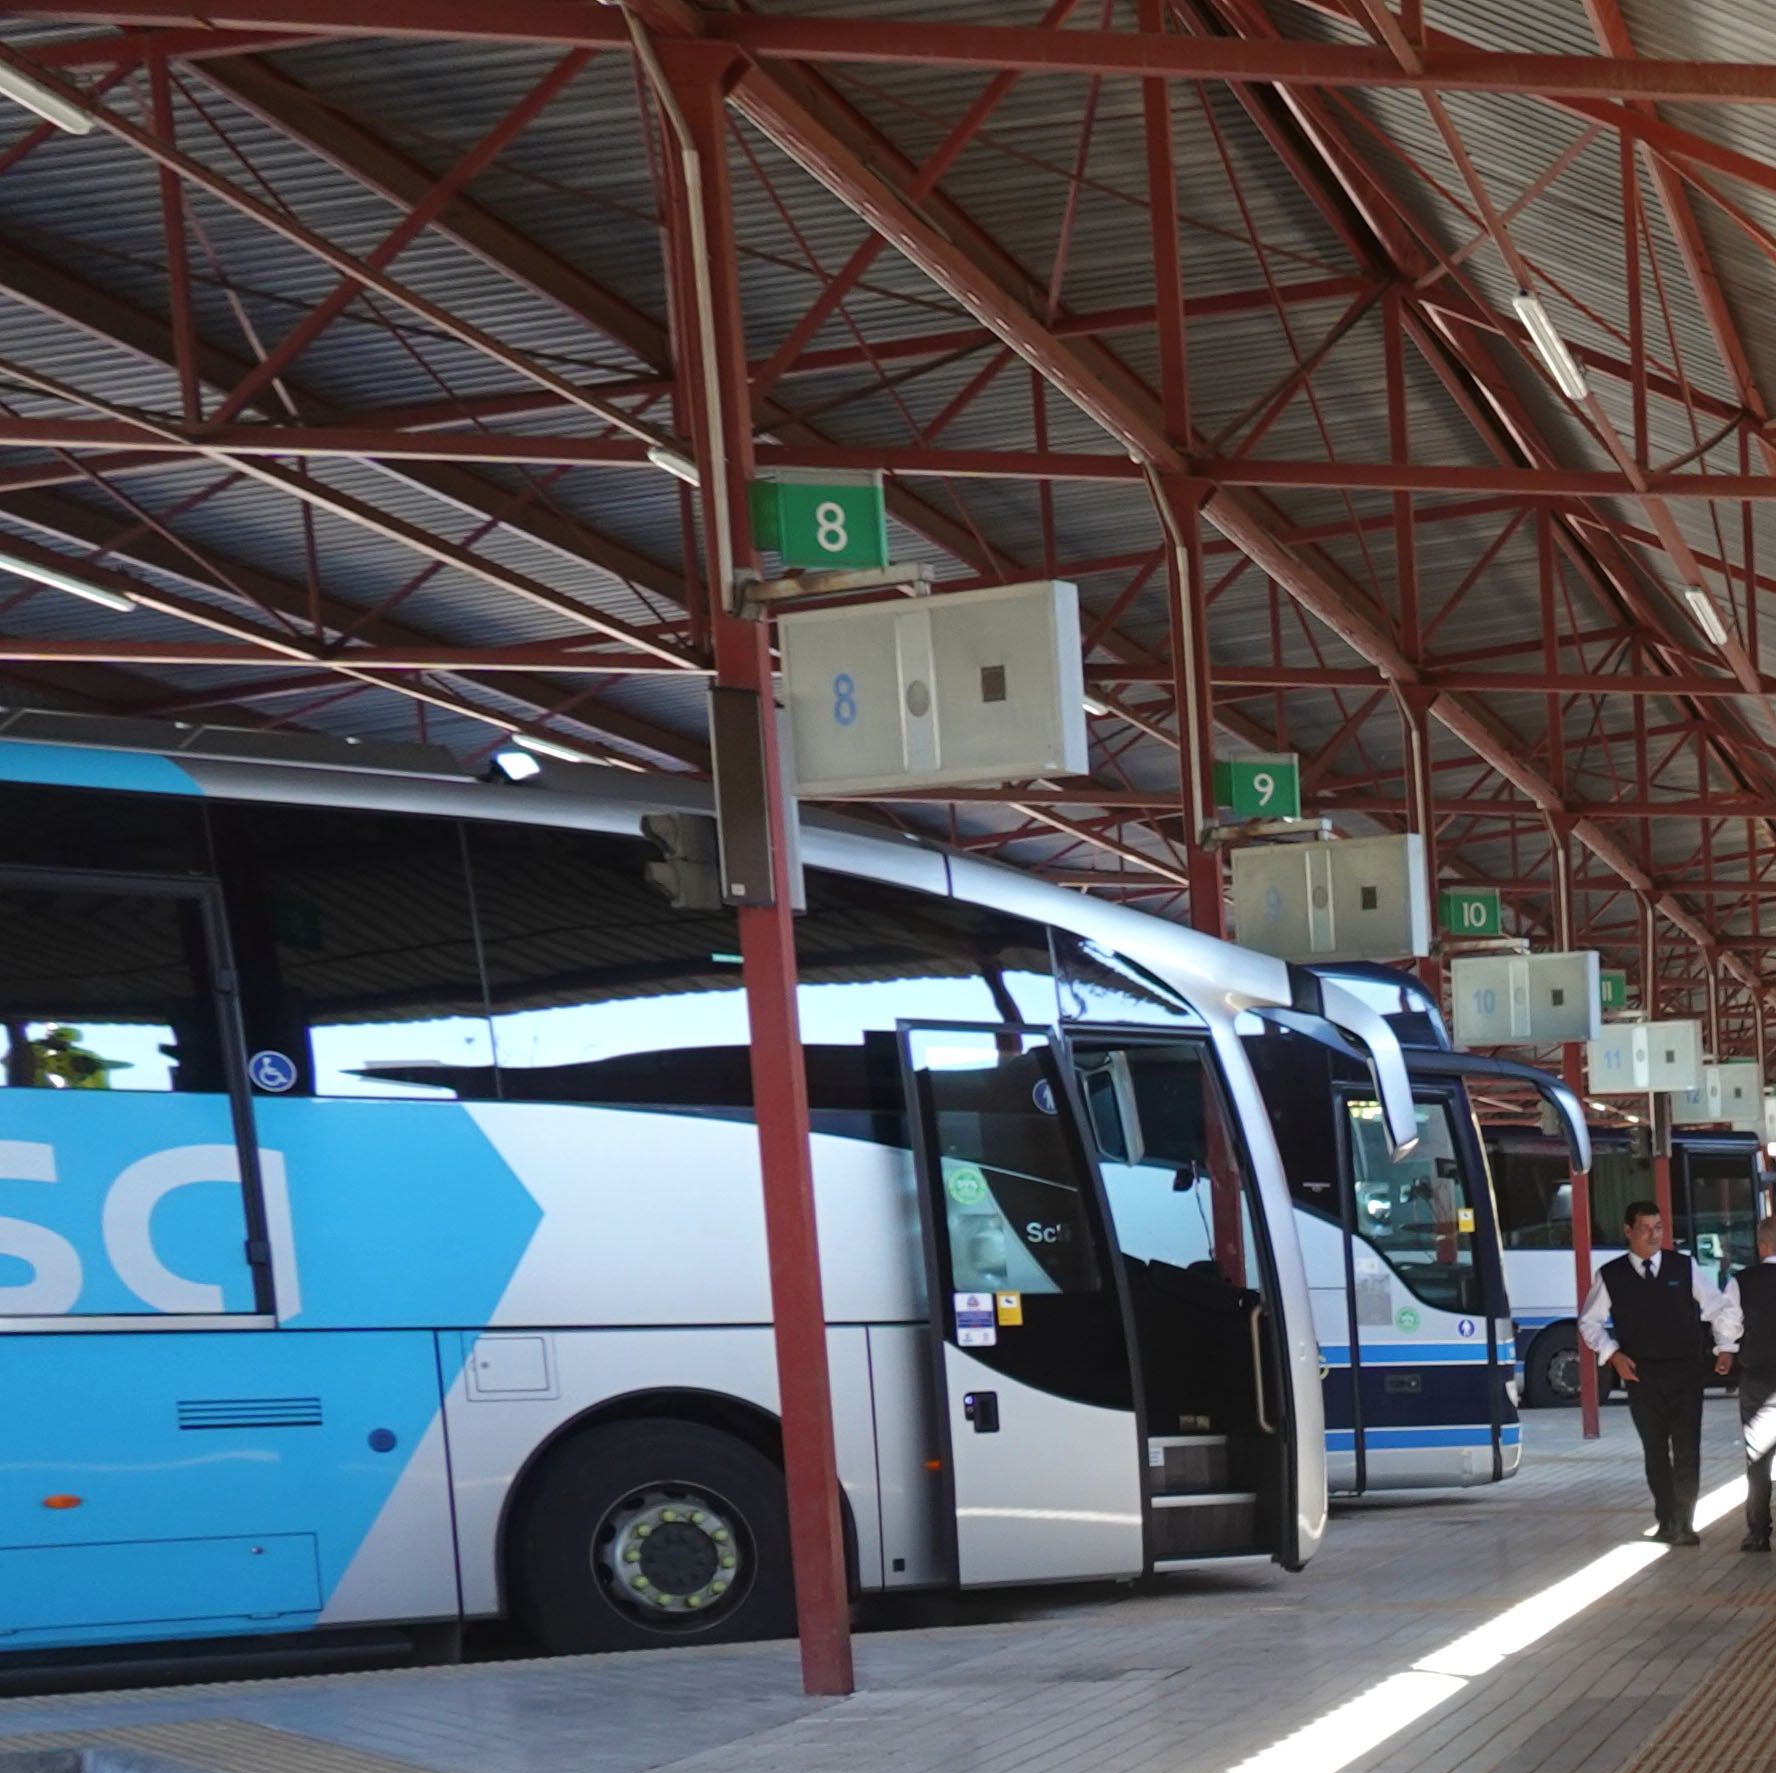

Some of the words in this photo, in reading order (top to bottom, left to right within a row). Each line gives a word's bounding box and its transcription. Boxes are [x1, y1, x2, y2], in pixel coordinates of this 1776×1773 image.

[815, 501, 848, 552] 8
[834, 673, 857, 725] 8
[1253, 773, 1275, 806] 9
[1461, 901, 1487, 928] 10
[1473, 990, 1495, 1014] 10
[1604, 1049, 1621, 1069] 11
